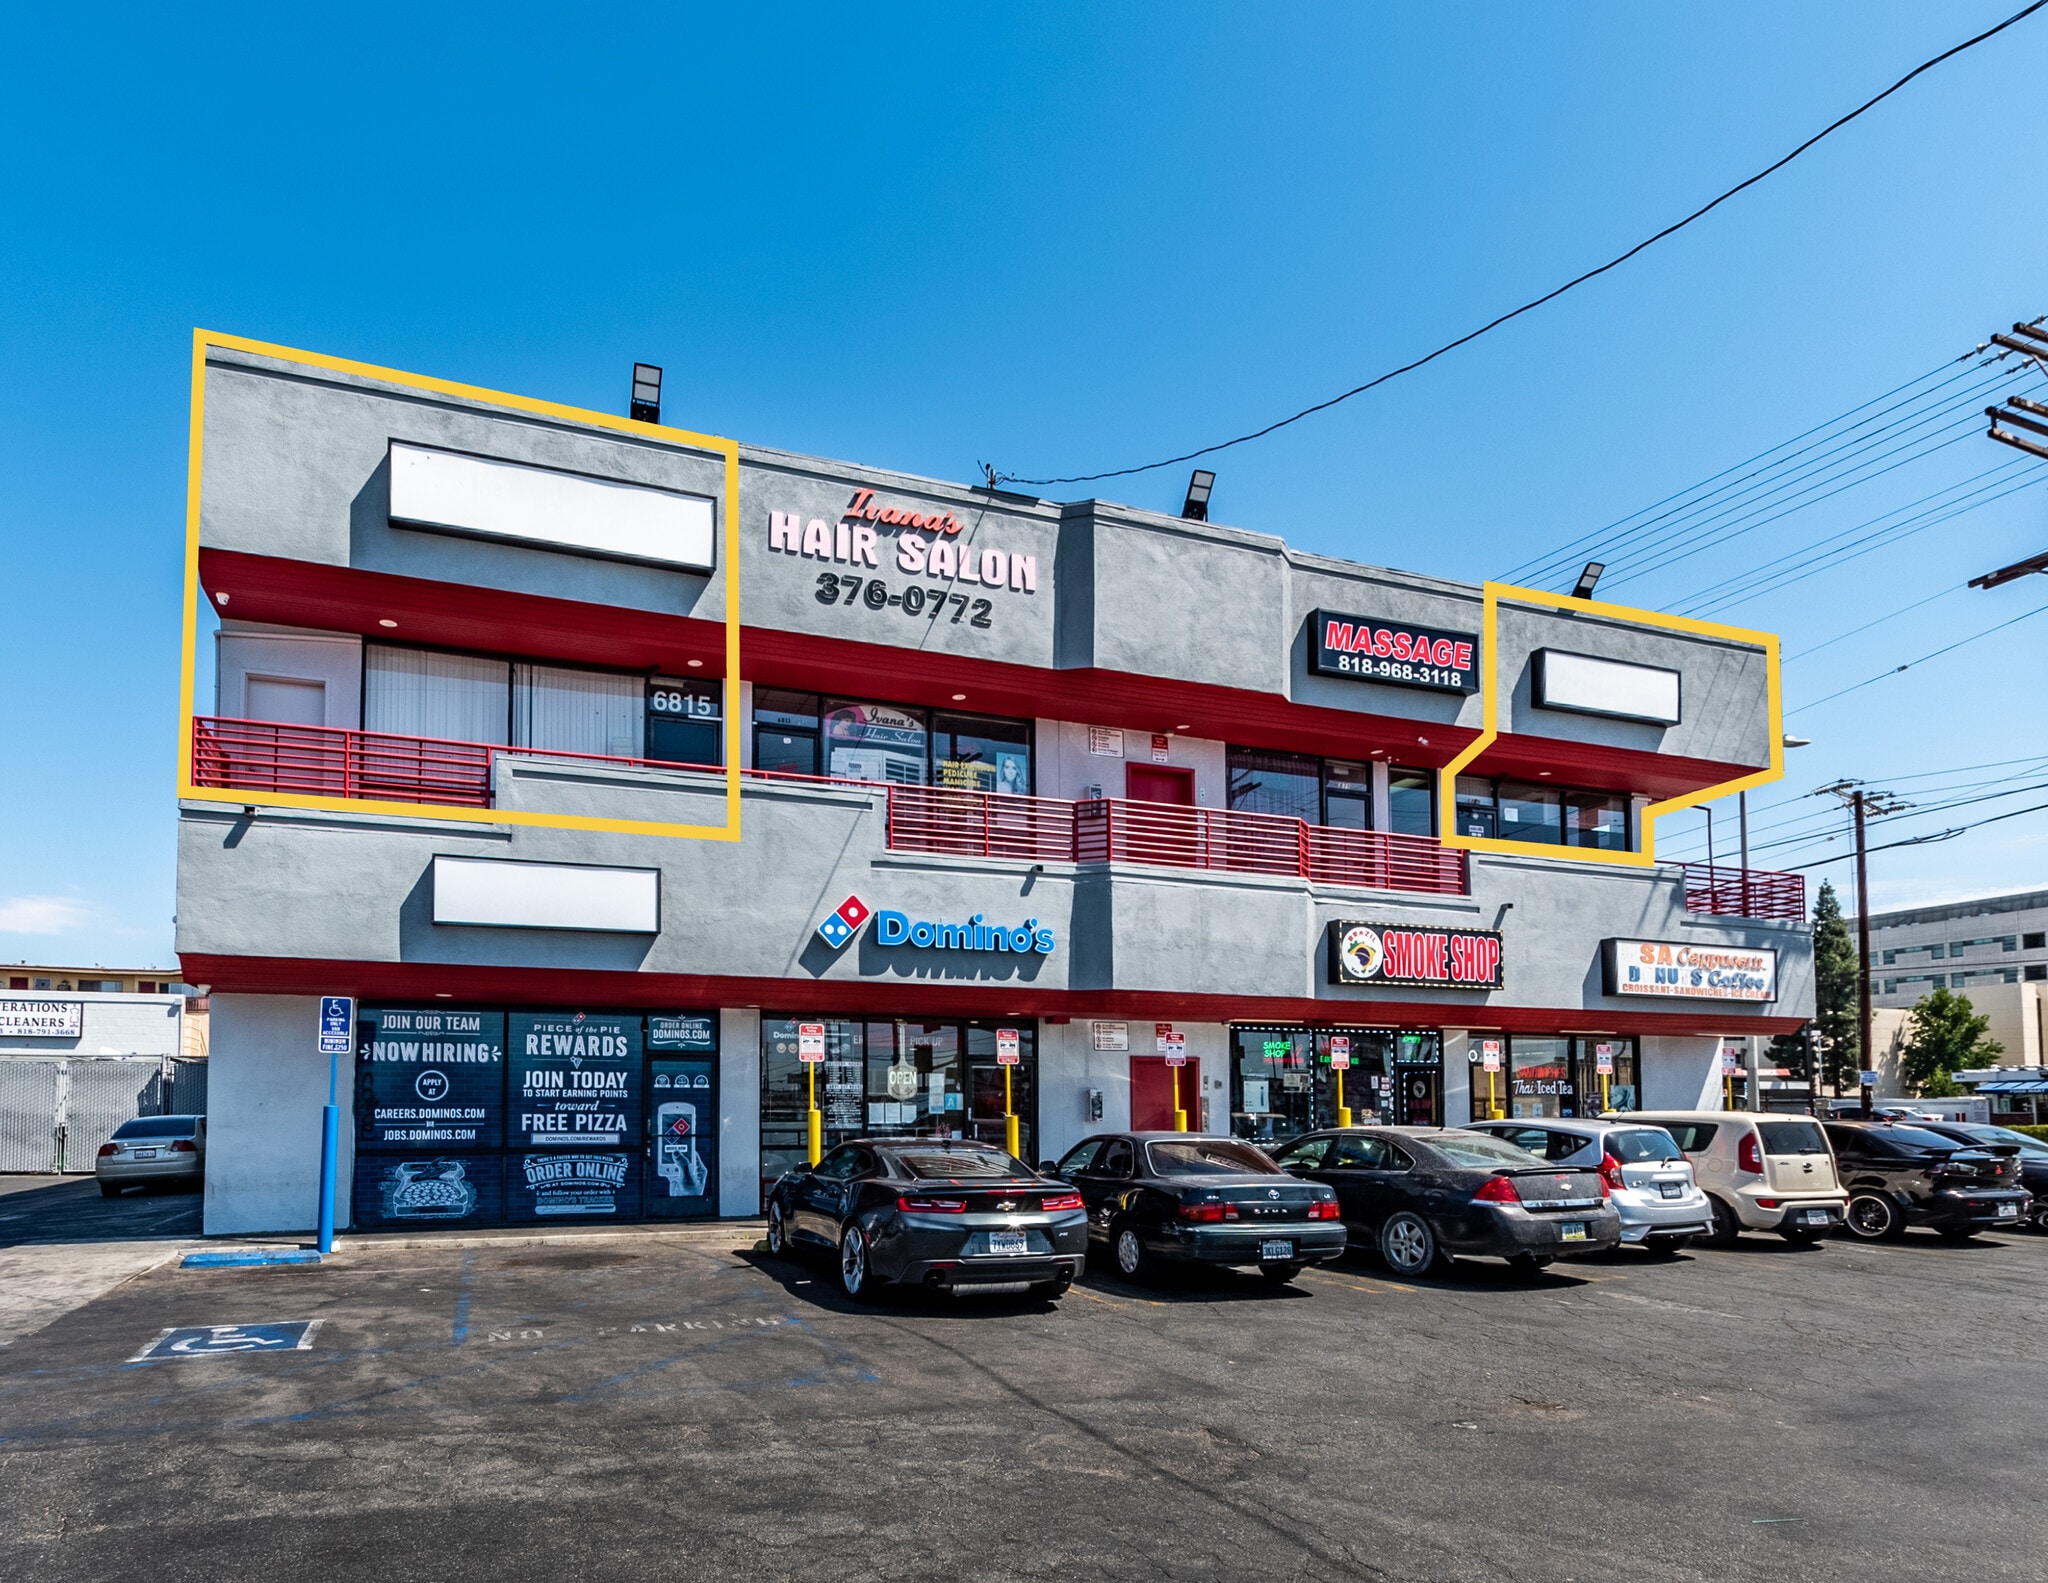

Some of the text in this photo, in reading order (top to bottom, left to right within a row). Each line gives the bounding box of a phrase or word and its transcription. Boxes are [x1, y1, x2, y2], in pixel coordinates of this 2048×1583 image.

[844, 488, 965, 535] Ivana's
[769, 511, 1037, 591] HAIR SALON
[815, 572, 993, 629] 376-0772
[1325, 620, 1473, 671] MASSAGE
[1338, 655, 1462, 687] 818-968-3118
[653, 690, 711, 716] 6815
[863, 707, 914, 728] Ivana's
[864, 728, 921, 745] Hair Salon
[878, 909, 1056, 954] Domino's
[1347, 929, 1377, 943] BRAZIL
[1382, 929, 1500, 983] SMOKE SHOP
[1629, 965, 1703, 987] DNUS
[0, 1002, 68, 1013] ERATIONS
[382, 1015, 480, 1031] JOIN OUR TEAM
[534, 1024, 572, 1033] PIECE
[575, 1026, 584, 1034] of
[600, 1026, 621, 1034] PIE
[681, 1022, 703, 1030] ONLINE
[653, 1029, 710, 1040] DOMINOS.COM
[773, 1030, 799, 1039] Domin
[910, 1036, 944, 1047] PICK UP
[372, 1041, 490, 1063] NOW HIRING
[526, 1034, 628, 1057] REWARDS
[1263, 1041, 1291, 1050] SMOKE
[1263, 1049, 1285, 1058] SHOP
[422, 1078, 442, 1086] APPLY
[523, 1070, 628, 1089] JOIN TODAY
[889, 1071, 917, 1085] OPEN
[522, 1089, 628, 1098] TO START EARNING POINTS
[1512, 1079, 1573, 1095] Thai Iced Tea
[374, 1108, 485, 1119] CAREERS.DOMINOS.COM
[555, 1100, 600, 1111] toward
[521, 1113, 628, 1132] FREE PIZZA
[383, 1129, 476, 1141] JOBS.DOMINOS.COM
[525, 1162, 627, 1184] ORDER ONLINE
[488, 1328, 544, 1343] NO
